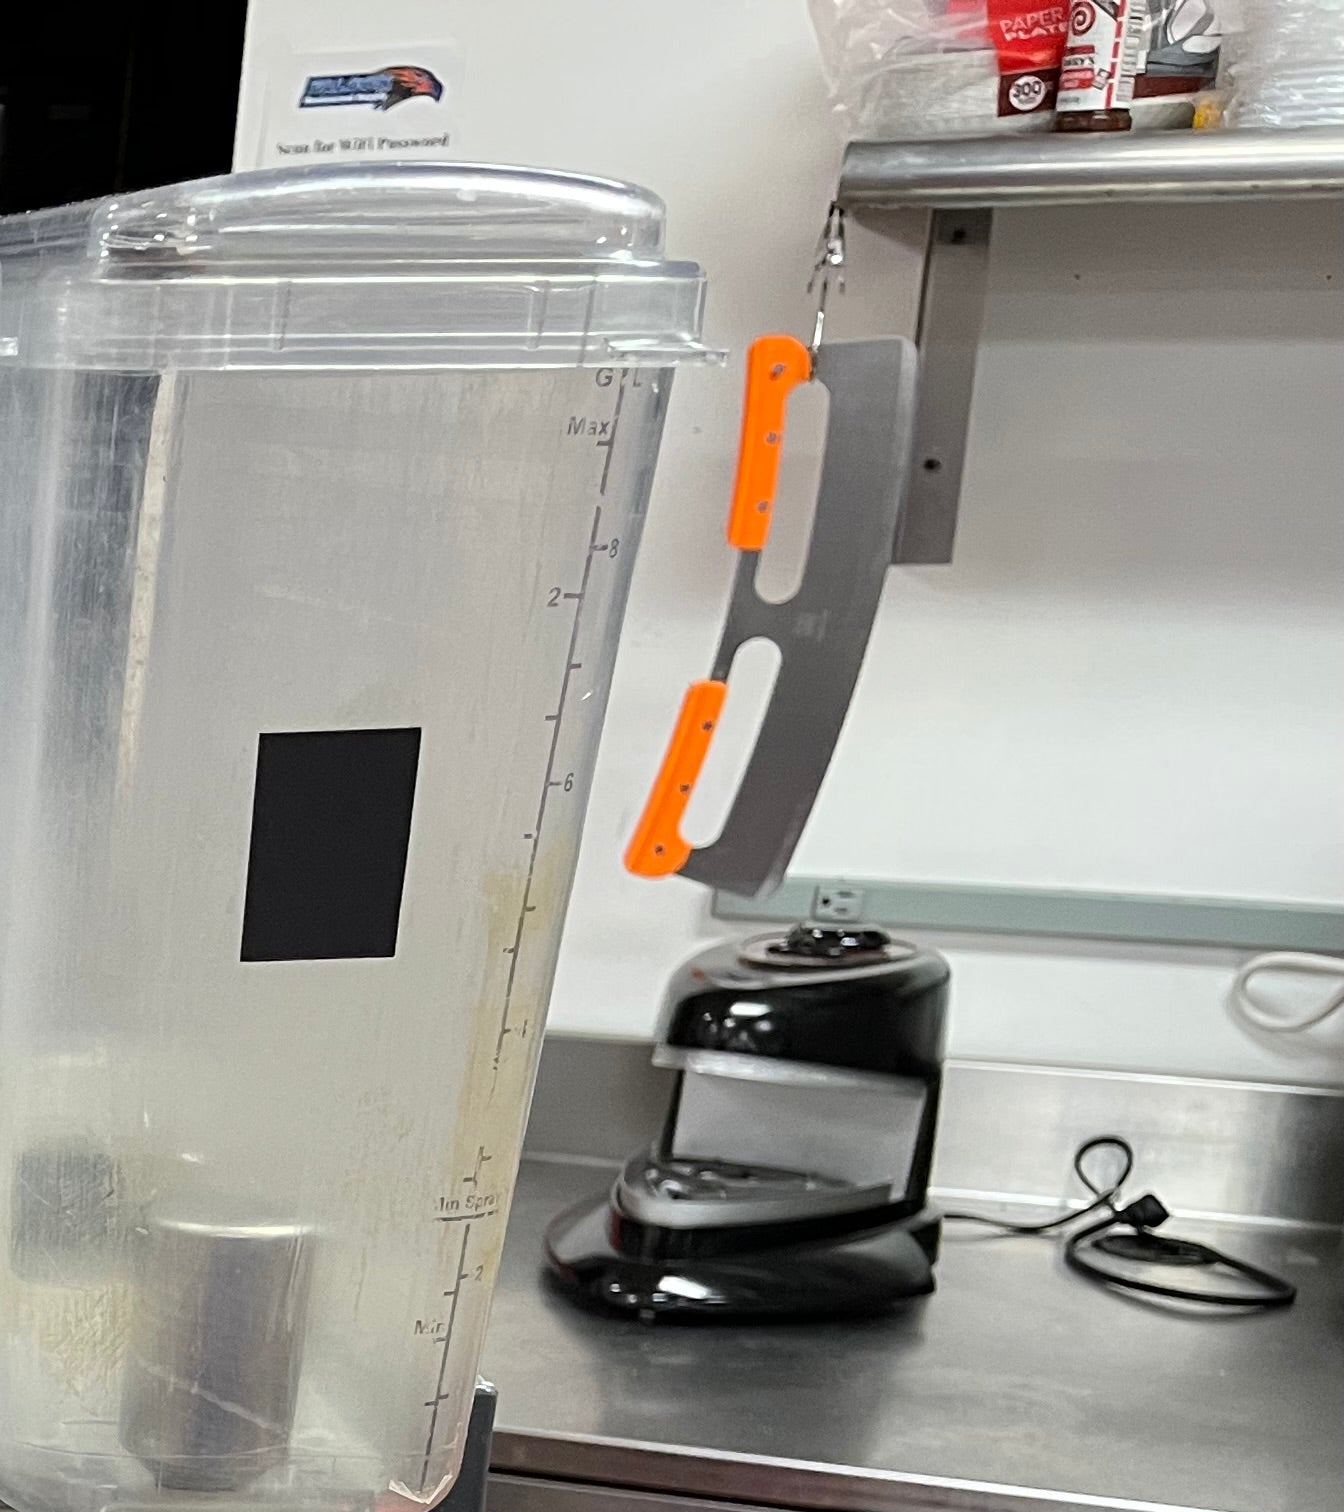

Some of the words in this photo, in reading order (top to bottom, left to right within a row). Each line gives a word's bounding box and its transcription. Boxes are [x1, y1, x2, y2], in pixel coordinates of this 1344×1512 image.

[999, 8, 1063, 33] PAPER
[596, 367, 614, 388] G
[567, 416, 611, 436] Max
[609, 539, 620, 558] 8
[547, 587, 562, 607] 2
[563, 773, 574, 792] 6
[474, 1264, 485, 1282] 2
